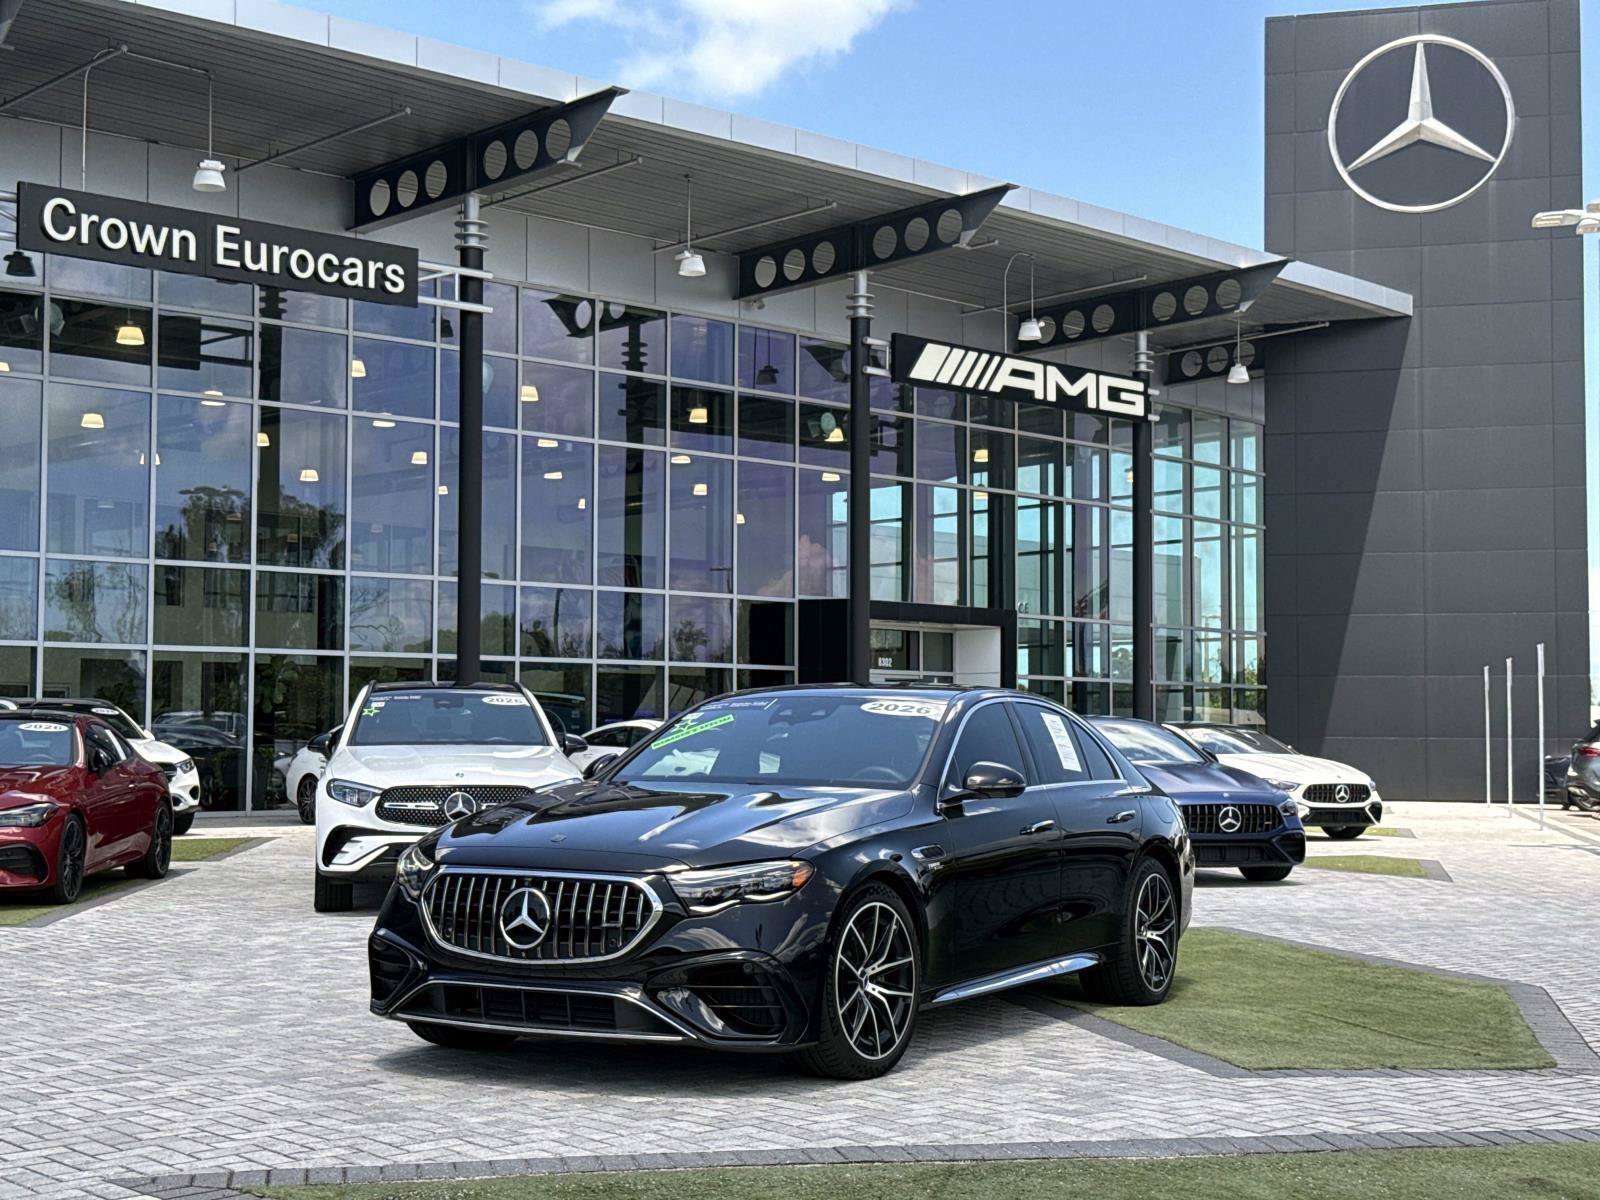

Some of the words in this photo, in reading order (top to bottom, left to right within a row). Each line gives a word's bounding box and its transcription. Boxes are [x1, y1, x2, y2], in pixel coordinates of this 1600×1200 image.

[42, 197, 197, 261] Crown
[215, 223, 406, 293] Eurocars
[989, 356, 1145, 416] AMG
[868, 702, 931, 715] 2026
